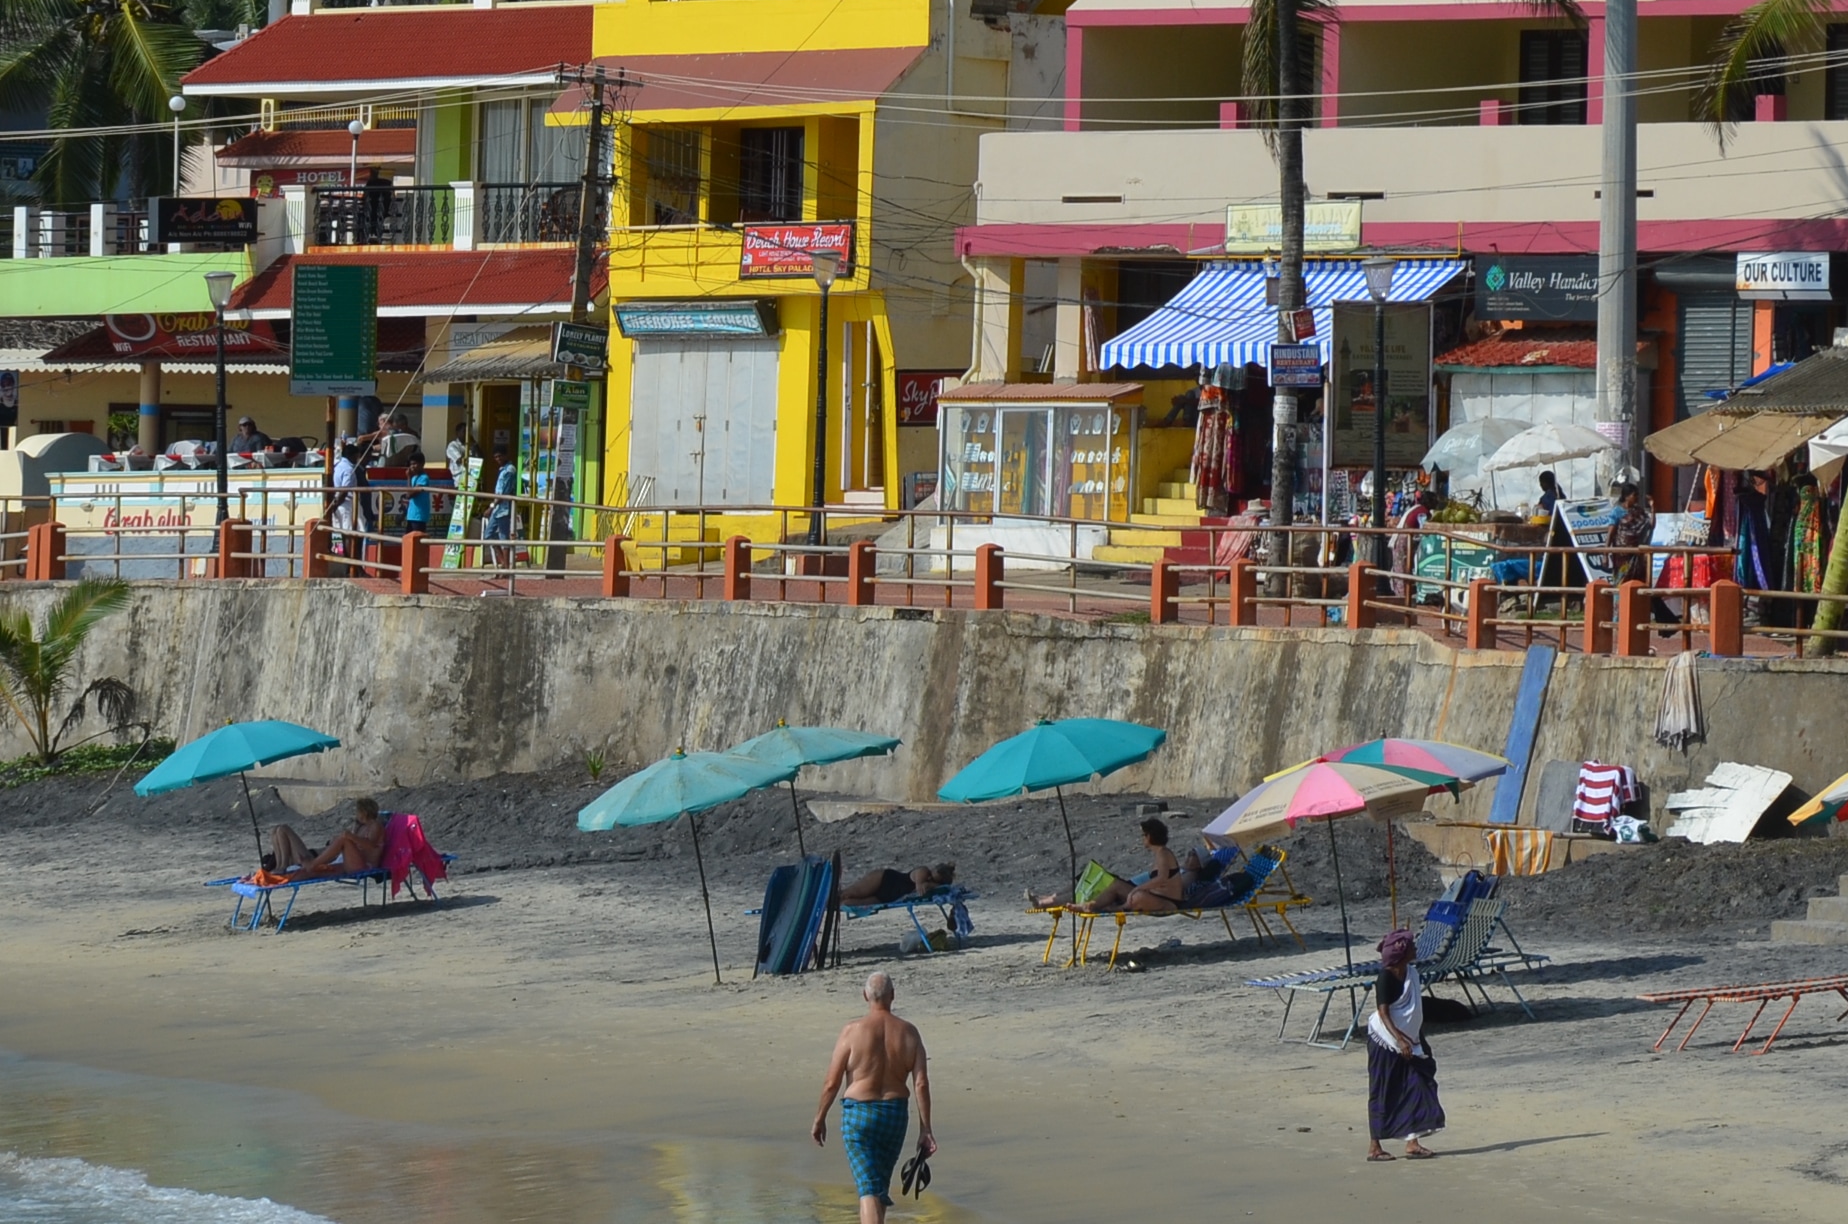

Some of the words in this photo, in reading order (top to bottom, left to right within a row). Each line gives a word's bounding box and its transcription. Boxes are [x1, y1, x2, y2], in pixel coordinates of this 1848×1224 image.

[296, 171, 346, 183] HOTEL
[773, 264, 786, 273] SKY
[788, 264, 814, 273] PALAC
[1744, 263, 1768, 282] OUR
[1771, 262, 1822, 282] CULTURE
[1508, 272, 1545, 294] Valley
[1549, 272, 1600, 290] Handicr
[1273, 348, 1318, 359] HINDUSTANI
[903, 380, 929, 415] Sky
[1571, 515, 1610, 528] spoonbi
[1576, 533, 1600, 544] FRESH
